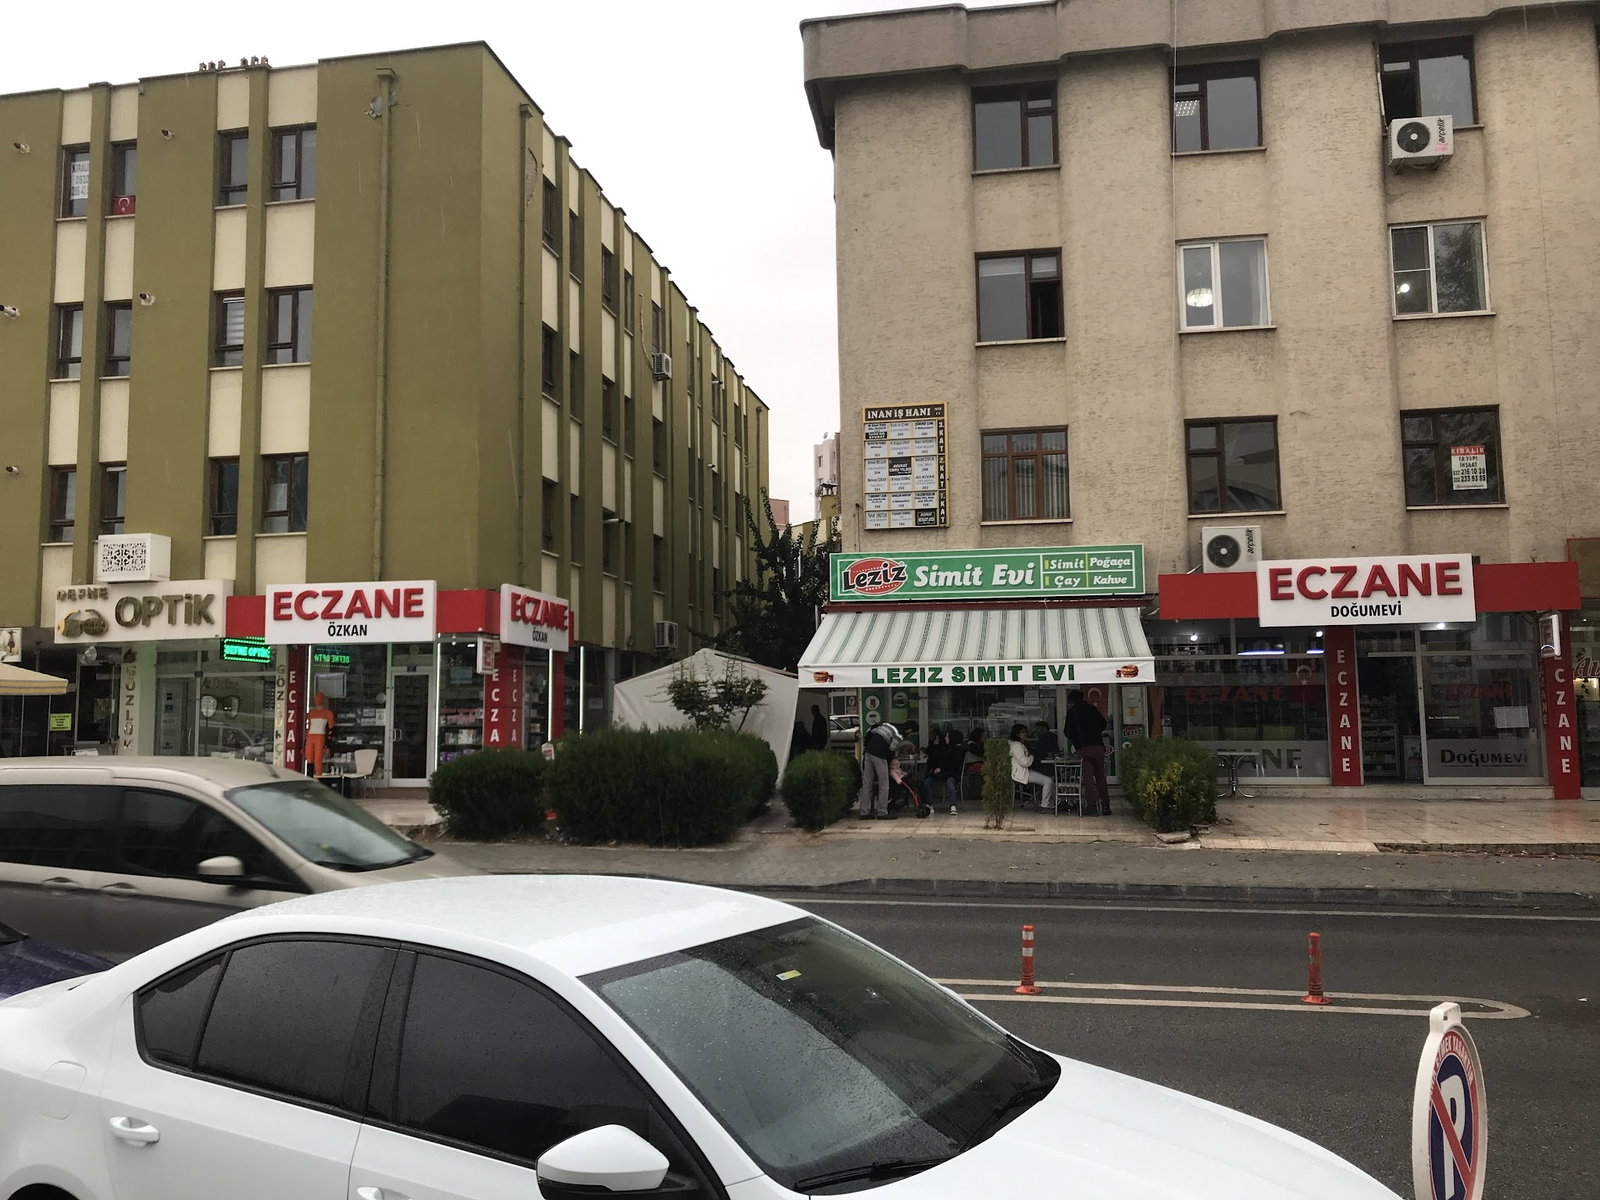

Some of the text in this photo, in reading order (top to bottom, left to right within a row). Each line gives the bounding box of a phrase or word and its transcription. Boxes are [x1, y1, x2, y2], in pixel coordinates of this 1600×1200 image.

[867, 410, 892, 418] İNAN
[906, 408, 930, 416] HANI
[843, 562, 1035, 591] Leziz Simit Evi
[1050, 559, 1084, 569] Simit
[1090, 557, 1131, 568] Poğaça
[1054, 576, 1080, 589] Çay
[1093, 575, 1128, 584] Kahve
[1268, 562, 1463, 600] ECZANE
[115, 594, 215, 628] OPTİK
[273, 588, 424, 621] ECZANE
[511, 592, 568, 630] ECZANE
[1330, 601, 1402, 618] DOĞUMEVİ
[328, 622, 368, 636] ÖZKAN
[872, 664, 1075, 684] LEZİZ SİMİT EVİ
[286, 671, 296, 762] ECZAN
[490, 668, 500, 742] ECZA
[1337, 650, 1352, 772] ECZANE
[1554, 656, 1572, 774] CZANE
